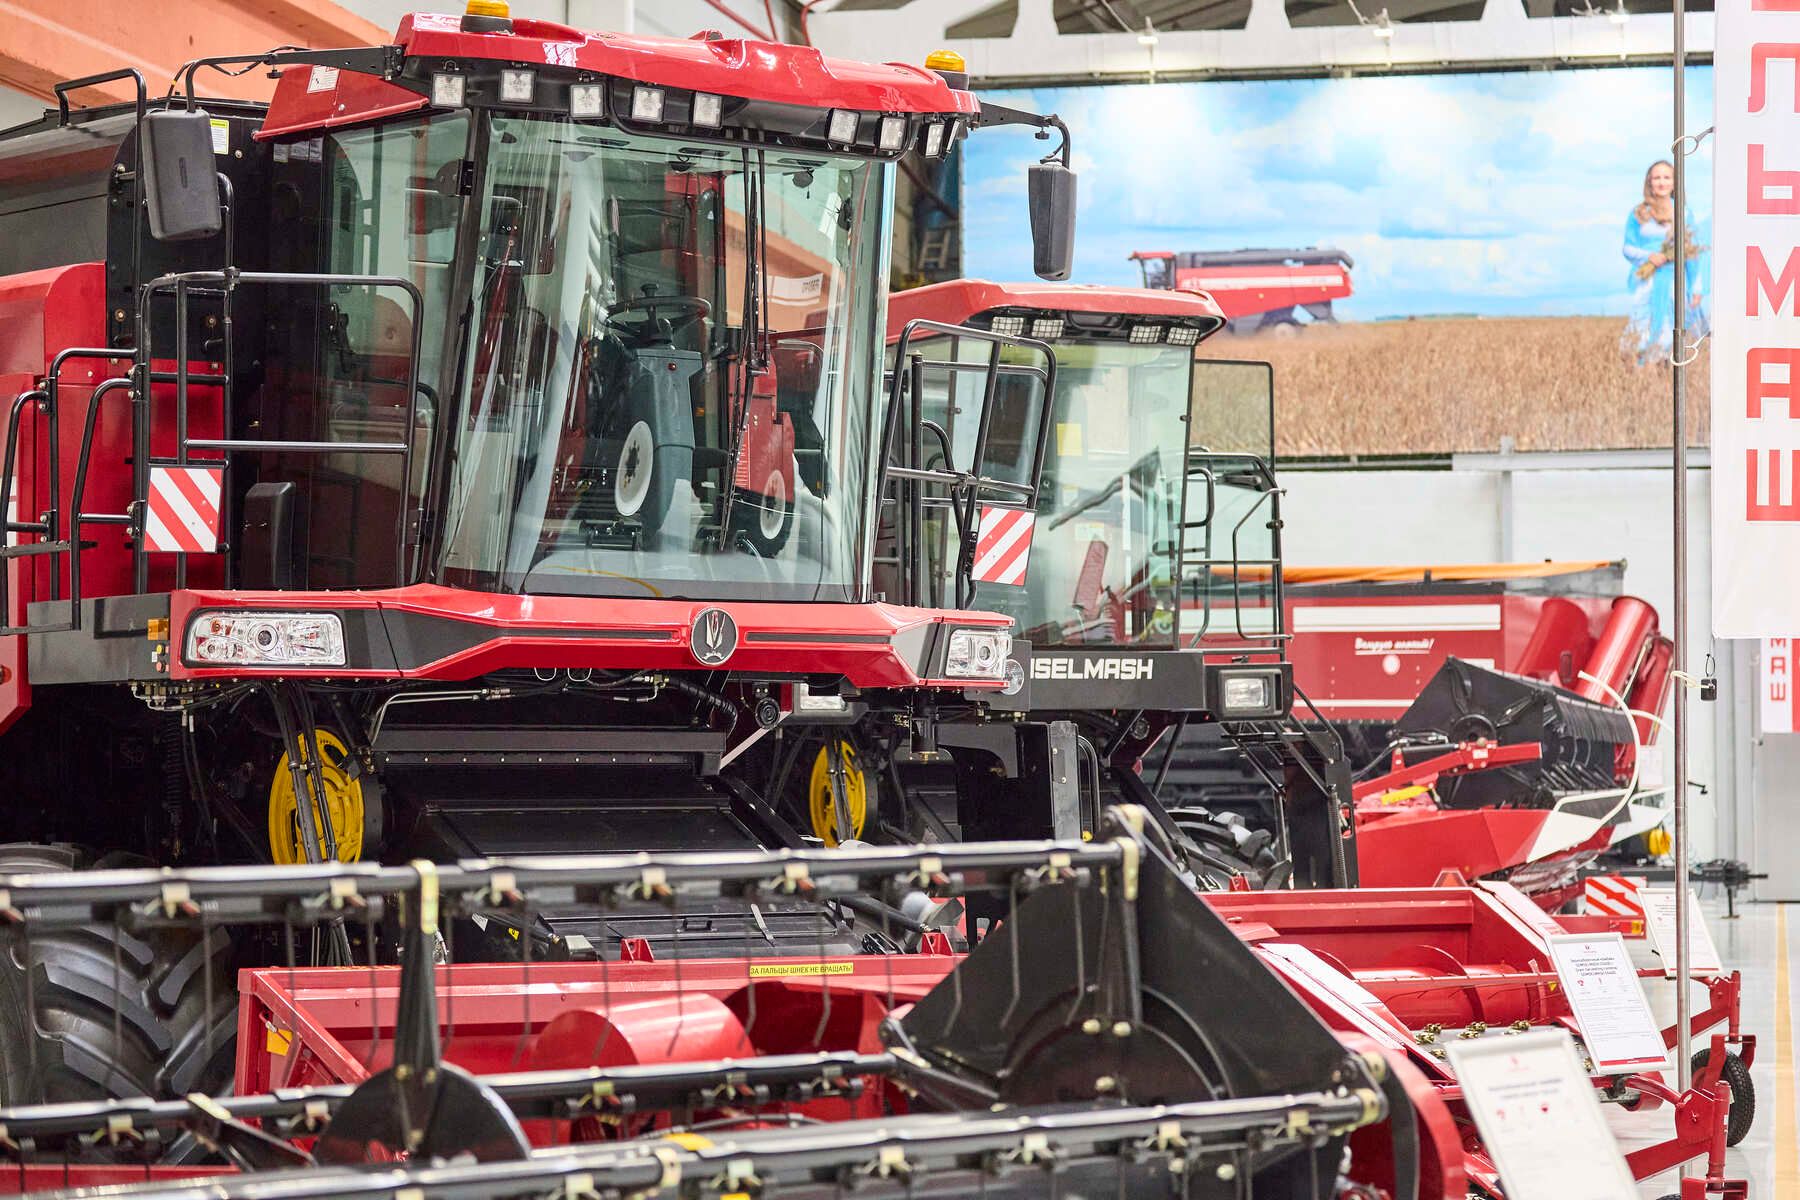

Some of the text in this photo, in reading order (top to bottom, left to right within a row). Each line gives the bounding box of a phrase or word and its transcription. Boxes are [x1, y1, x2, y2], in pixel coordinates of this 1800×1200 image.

[1745, 0, 1800, 521] ЛЬМАШ
[750, 967, 760, 975] ЗА
[760, 966, 789, 976] ПАЛЬЦЫ
[810, 965, 819, 973] НЕ
